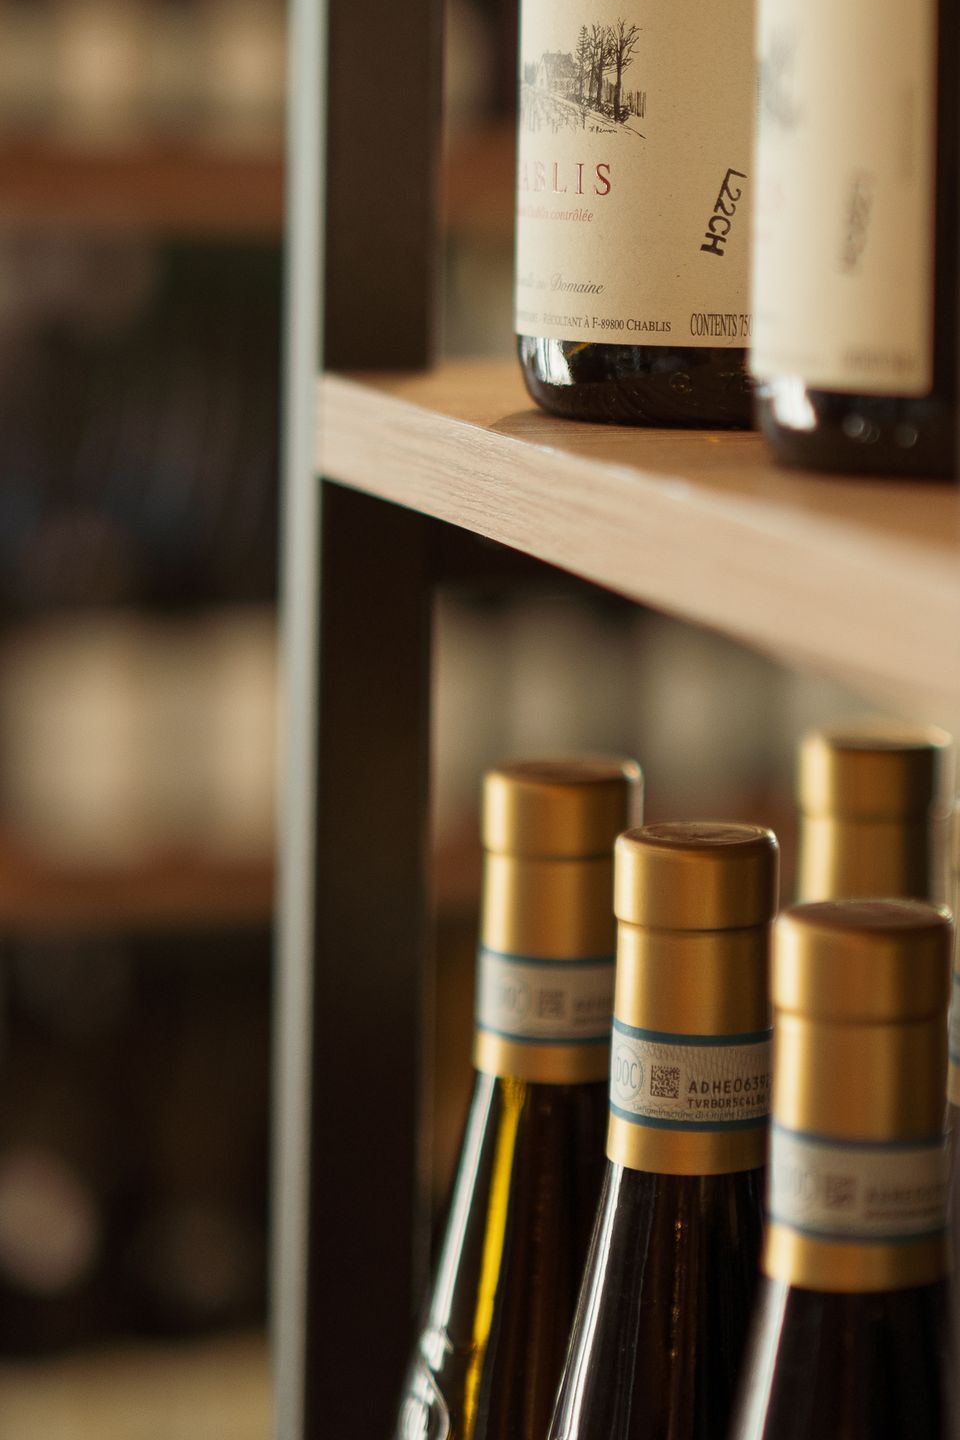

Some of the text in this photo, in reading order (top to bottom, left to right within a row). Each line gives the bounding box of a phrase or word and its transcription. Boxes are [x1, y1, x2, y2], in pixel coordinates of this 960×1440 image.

[701, 168, 748, 256] L22CH
[550, 274, 607, 295] Domaine
[592, 317, 625, 330] F-89800
[690, 313, 738, 336] CONTENTS
